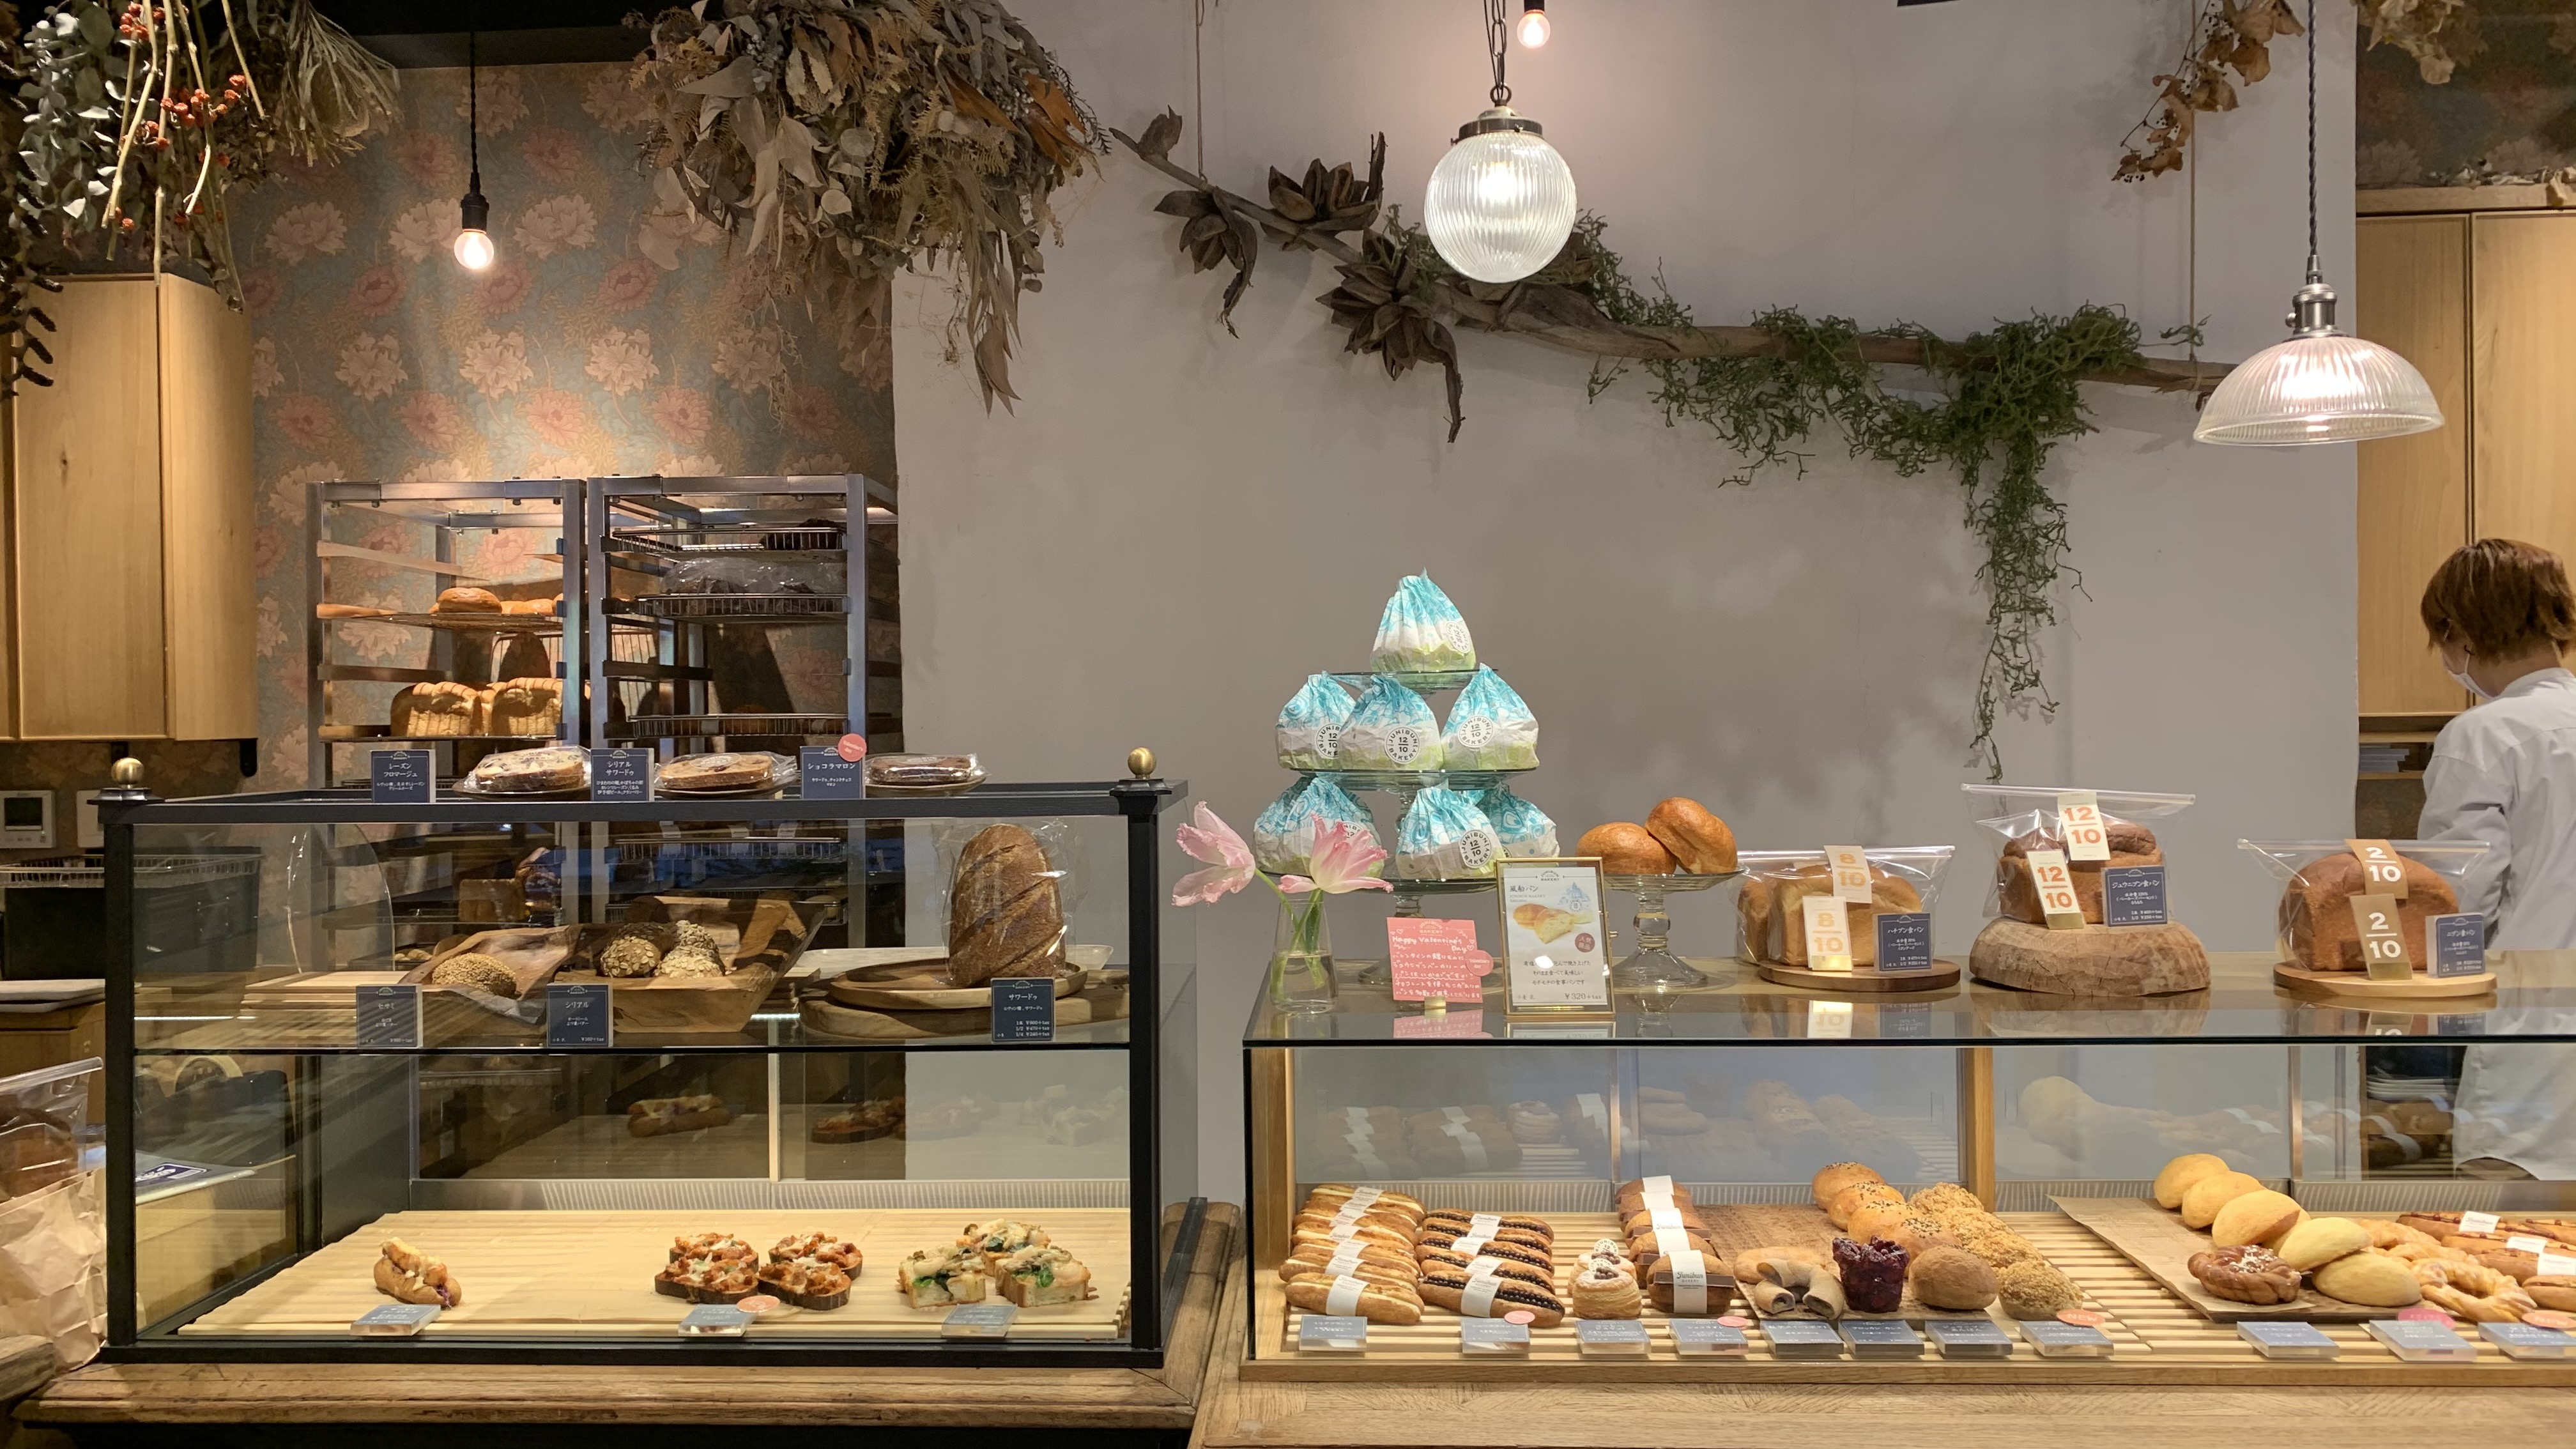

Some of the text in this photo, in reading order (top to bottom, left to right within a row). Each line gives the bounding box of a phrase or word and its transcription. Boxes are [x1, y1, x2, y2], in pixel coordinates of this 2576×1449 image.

[1462, 717, 1491, 733] JUNIBUN
[1389, 730, 1418, 743] JUNIBUN
[1462, 731, 1491, 744] BAKERY
[1389, 748, 1416, 760] BAKERY
[2064, 807, 2096, 822] 12
[1462, 832, 1488, 850] JUNIBUN
[2071, 829, 2101, 844] 10
[1464, 848, 1490, 864] BAKERY
[1840, 853, 1856, 864] 8
[2365, 847, 2388, 859] 2
[1837, 871, 1866, 887] 10
[2037, 866, 2066, 882] 12
[2369, 865, 2402, 882] 10
[2112, 880, 2160, 889] ジュウニブン食パン
[2046, 892, 2073, 908] 10
[1818, 912, 1835, 927] 8
[2369, 912, 2389, 930] 2
[1887, 926, 1924, 934] ハチブン食パン
[1392, 936, 1462, 946] Happy Valentine's
[1814, 937, 1843, 952] 10
[1452, 945, 1468, 954] Day
[2370, 940, 2401, 958] 10
[2067, 1313, 2097, 1321] NEW
